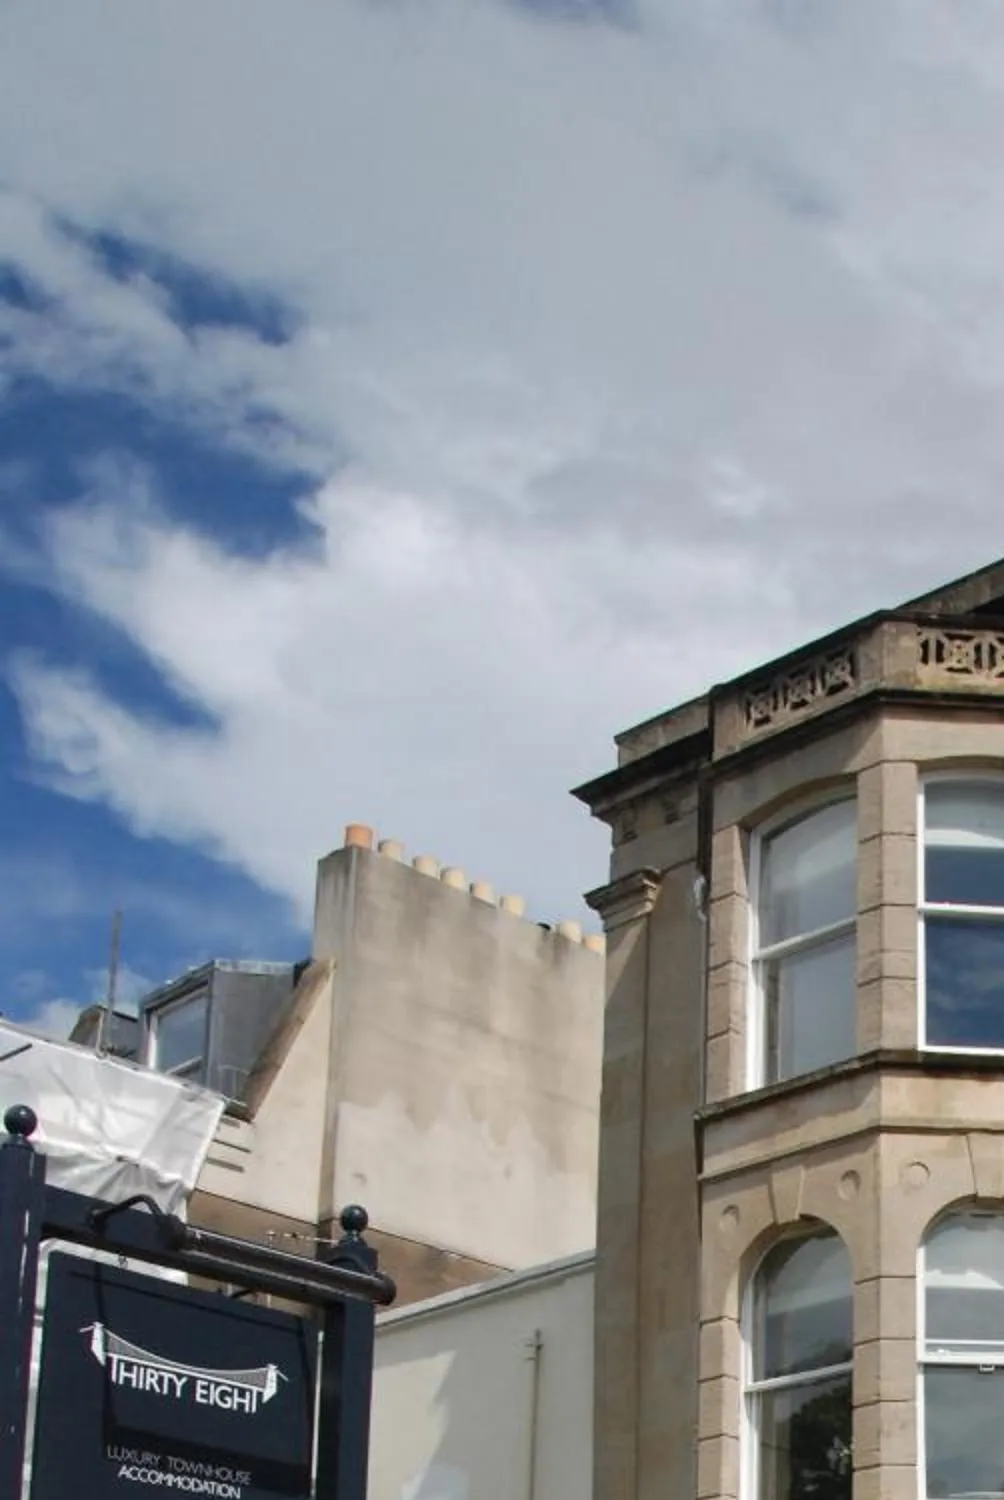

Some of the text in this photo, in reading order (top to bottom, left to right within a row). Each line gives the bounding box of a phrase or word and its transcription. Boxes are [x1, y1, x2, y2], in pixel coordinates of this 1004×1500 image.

[108, 1354, 260, 1413] THIRTY EIGHT
[107, 1445, 251, 1485] LUXURY TOWNHOUSE
[118, 1465, 241, 1499] ACCOMMODATION
